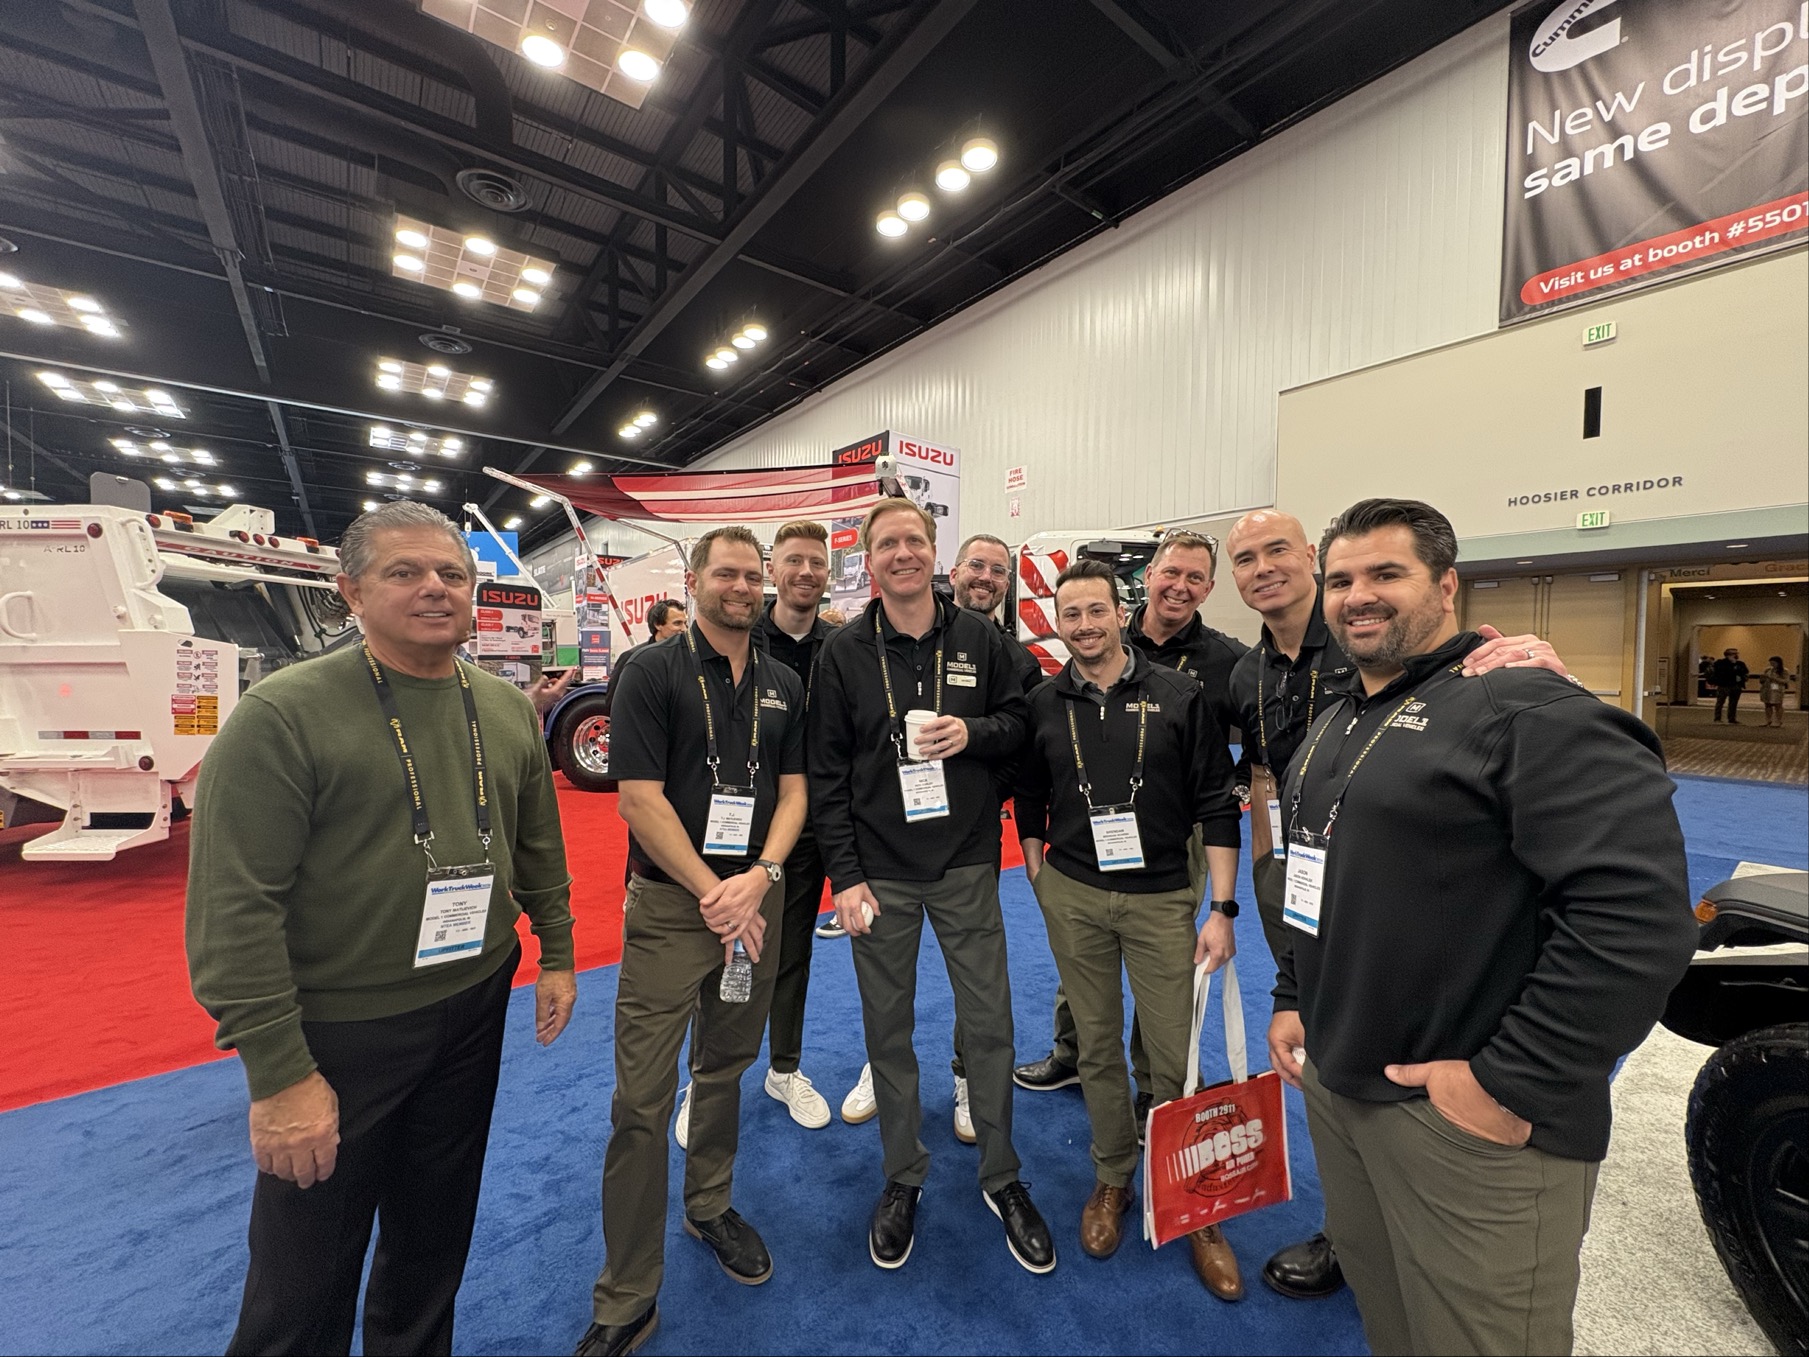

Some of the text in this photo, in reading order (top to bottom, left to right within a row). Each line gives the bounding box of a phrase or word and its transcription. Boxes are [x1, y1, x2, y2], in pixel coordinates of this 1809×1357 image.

[1526, 81, 1645, 155] New
[1523, 121, 1671, 199] same
[1539, 272, 1585, 293] Visit
[1589, 263, 1614, 280] us
[1619, 254, 1643, 271] at
[1648, 231, 1719, 262] booth
[1588, 323, 1612, 342] EXIT
[838, 440, 882, 463] ISUZU
[899, 440, 954, 466] ISUZU
[1008, 475, 1023, 483] HOSE
[1010, 468, 1022, 476] FIRE
[1507, 475, 1683, 507] HOOSIER CORRIDOR
[17, 520, 30, 530] 10
[1582, 511, 1606, 528] EXIT
[185, 545, 294, 567] CAUTION
[1669, 567, 1711, 578] Merci
[482, 589, 538, 607] ISUZU
[472, 720, 482, 766] PROFESSIONAL
[405, 759, 423, 810] PROFESSIONAL
[431, 883, 482, 894] WorkTruckWeek
[1195, 1103, 1236, 1124] BOOTH 2911
[1198, 1118, 1264, 1171] BOSS
